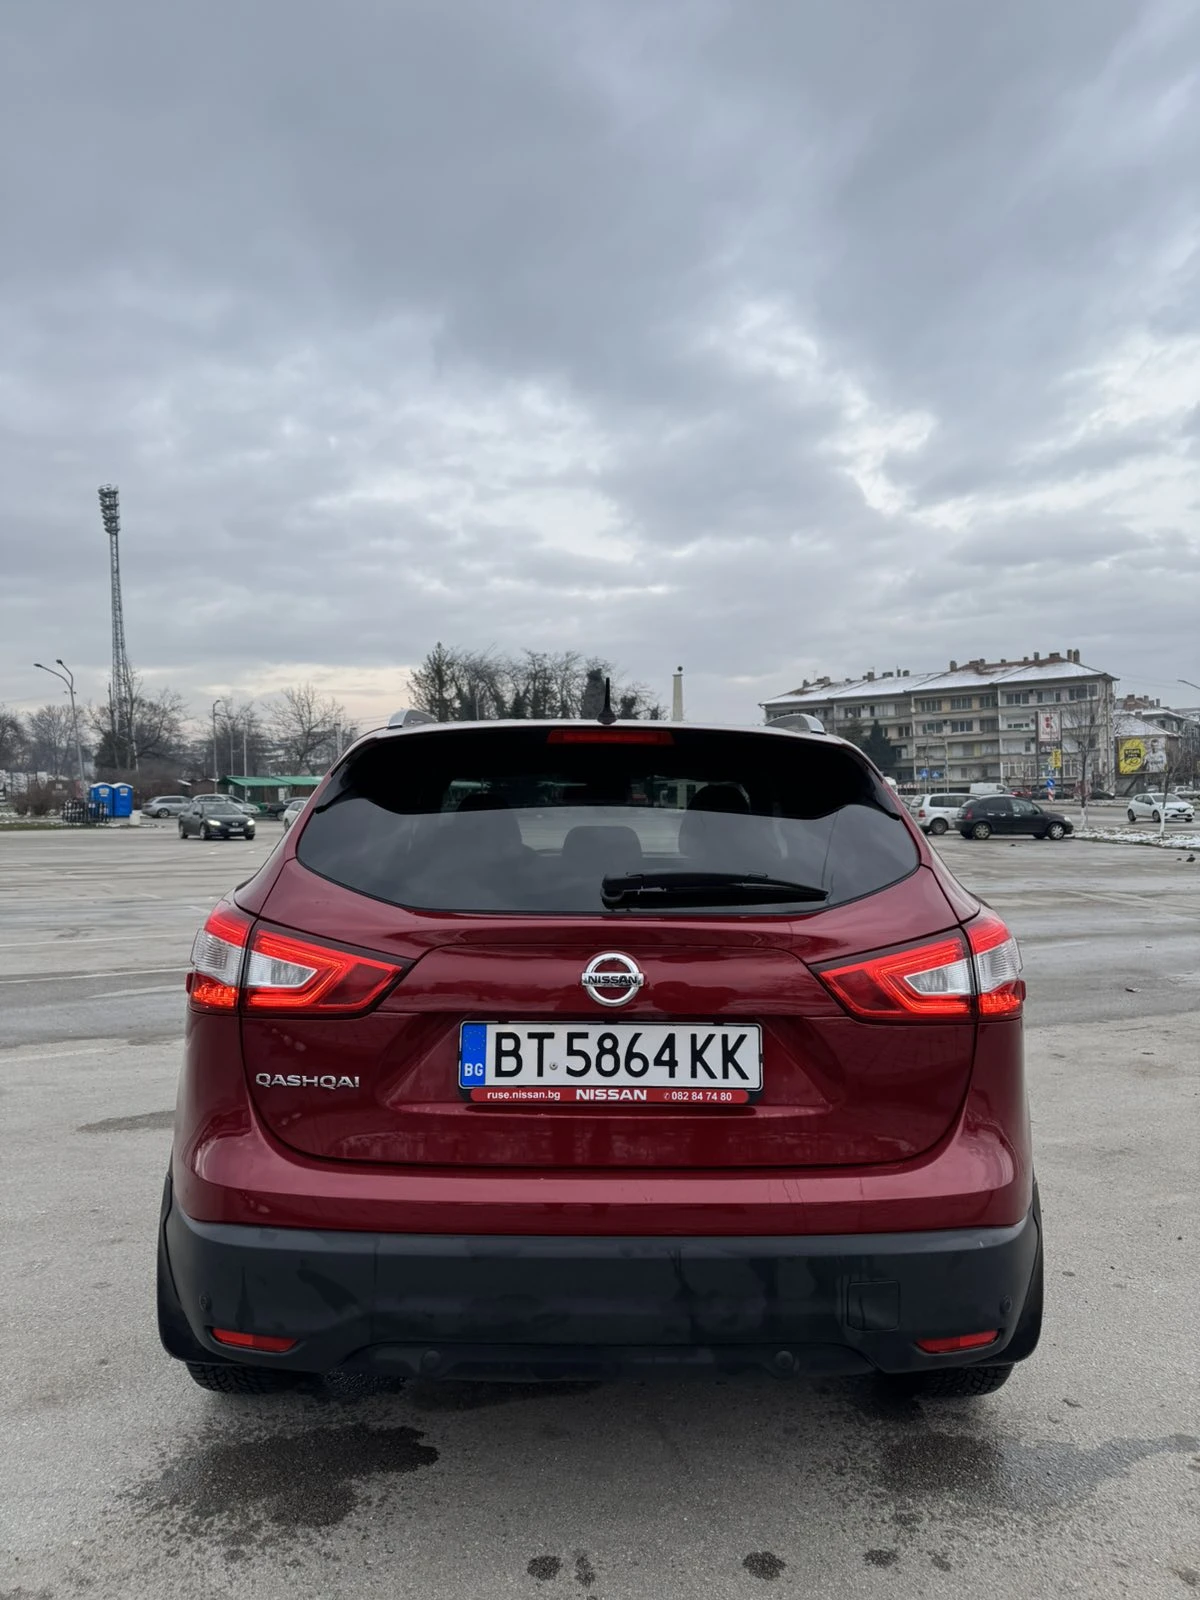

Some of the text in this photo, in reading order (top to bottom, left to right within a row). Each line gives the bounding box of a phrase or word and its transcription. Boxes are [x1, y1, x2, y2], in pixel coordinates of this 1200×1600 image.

[588, 975, 638, 984] NISSAN
[494, 1031, 750, 1080] BT 5864 KK
[464, 1063, 483, 1076] BG
[255, 1073, 360, 1090] QASHQAI
[487, 1090, 561, 1101] ruse.nissan.bg
[576, 1089, 647, 1101] NISSAN
[671, 1091, 733, 1101] 082 84 74 80
